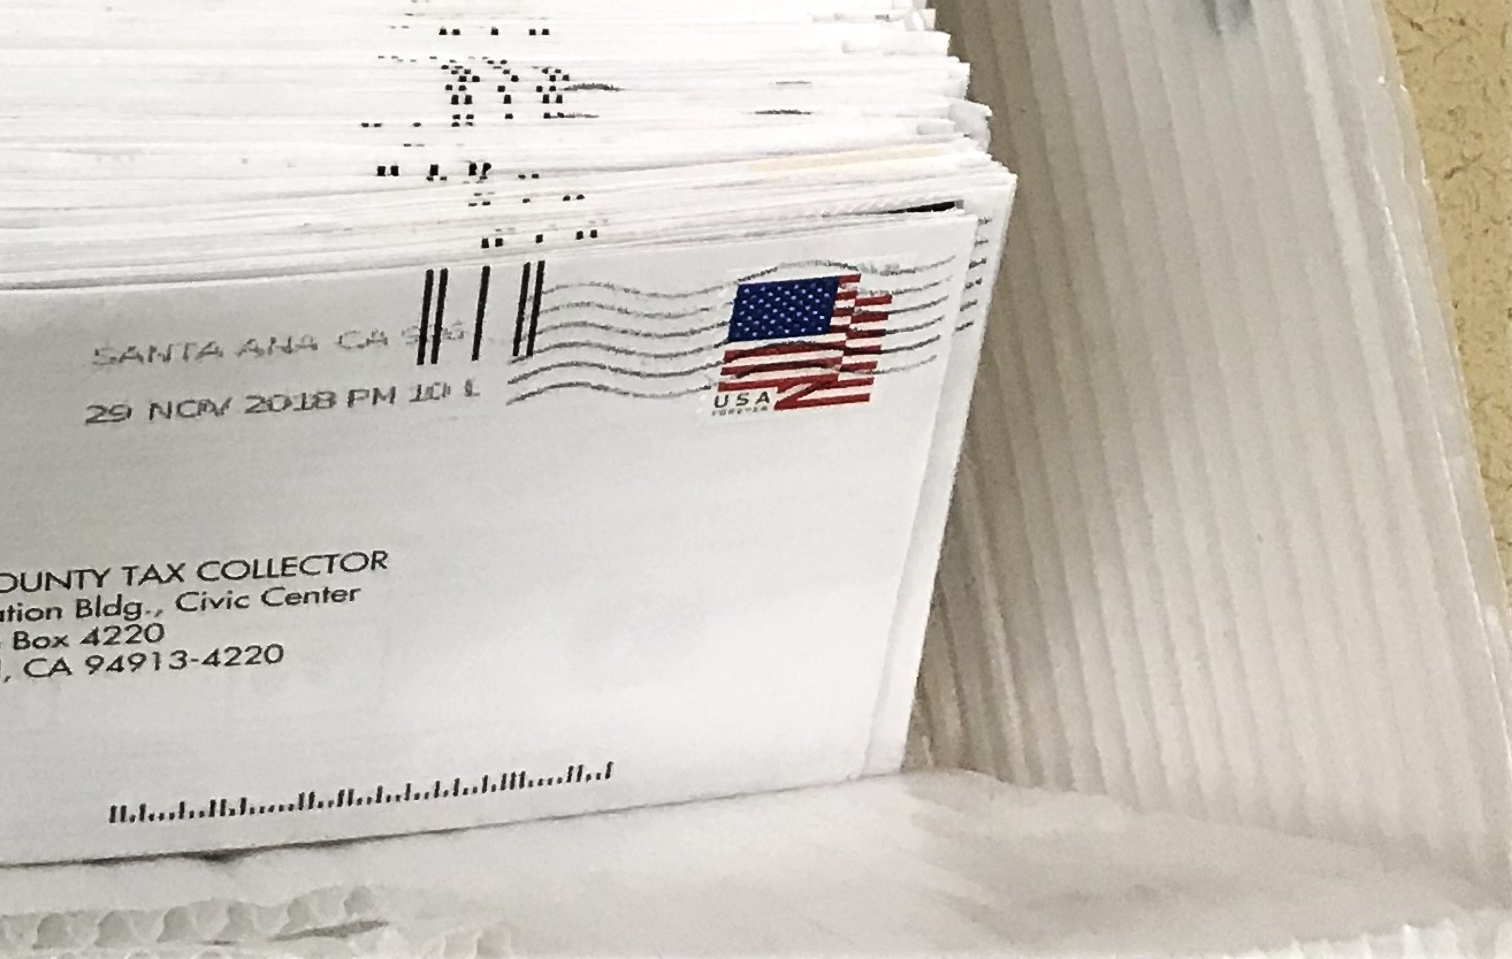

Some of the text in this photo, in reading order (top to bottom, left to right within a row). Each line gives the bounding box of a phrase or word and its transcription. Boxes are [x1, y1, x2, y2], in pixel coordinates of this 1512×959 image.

[92, 341, 223, 367] SANTA
[237, 333, 318, 358] ANA
[338, 328, 388, 350] CA
[86, 403, 131, 424] 29
[149, 396, 232, 421] NOV
[244, 391, 337, 415] 2018
[347, 385, 396, 408] PM
[714, 390, 771, 409] USA
[121, 561, 185, 585] TAX
[196, 549, 390, 582] COLLECTOR
[74, 595, 165, 622] Bldg.,
[176, 588, 250, 613] Civic
[261, 584, 362, 608] Center
[12, 628, 70, 650] Box
[79, 622, 166, 646] 4220
[23, 654, 73, 679] CA
[84, 642, 285, 677] 94913-4220
